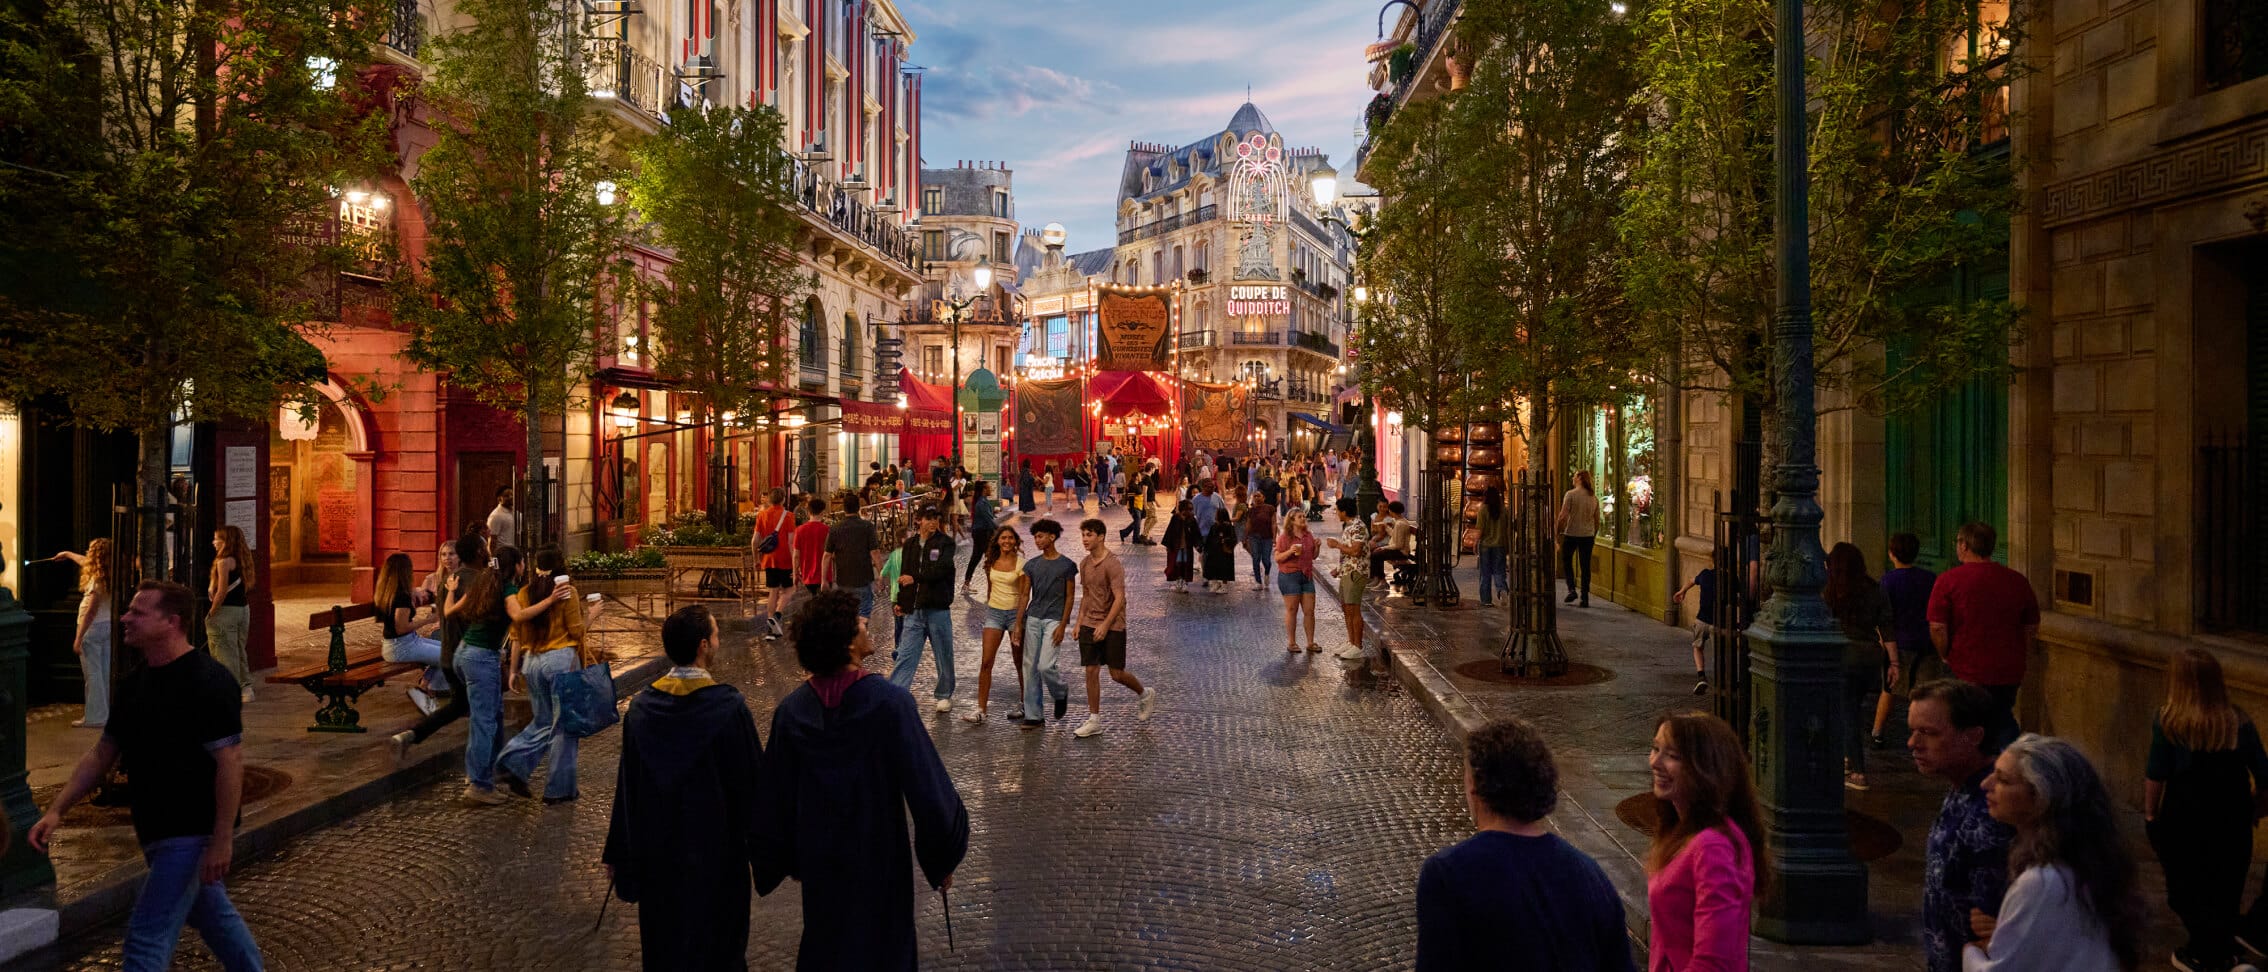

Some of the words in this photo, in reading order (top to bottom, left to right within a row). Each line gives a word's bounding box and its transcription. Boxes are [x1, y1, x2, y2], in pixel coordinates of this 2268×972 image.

[1245, 213, 1272, 221] PARIS
[1231, 286, 1268, 300] COUPE
[1272, 286, 1287, 300] DE
[1104, 309, 1166, 320] ARCANUS
[1227, 301, 1291, 317] QUIDDITCH
